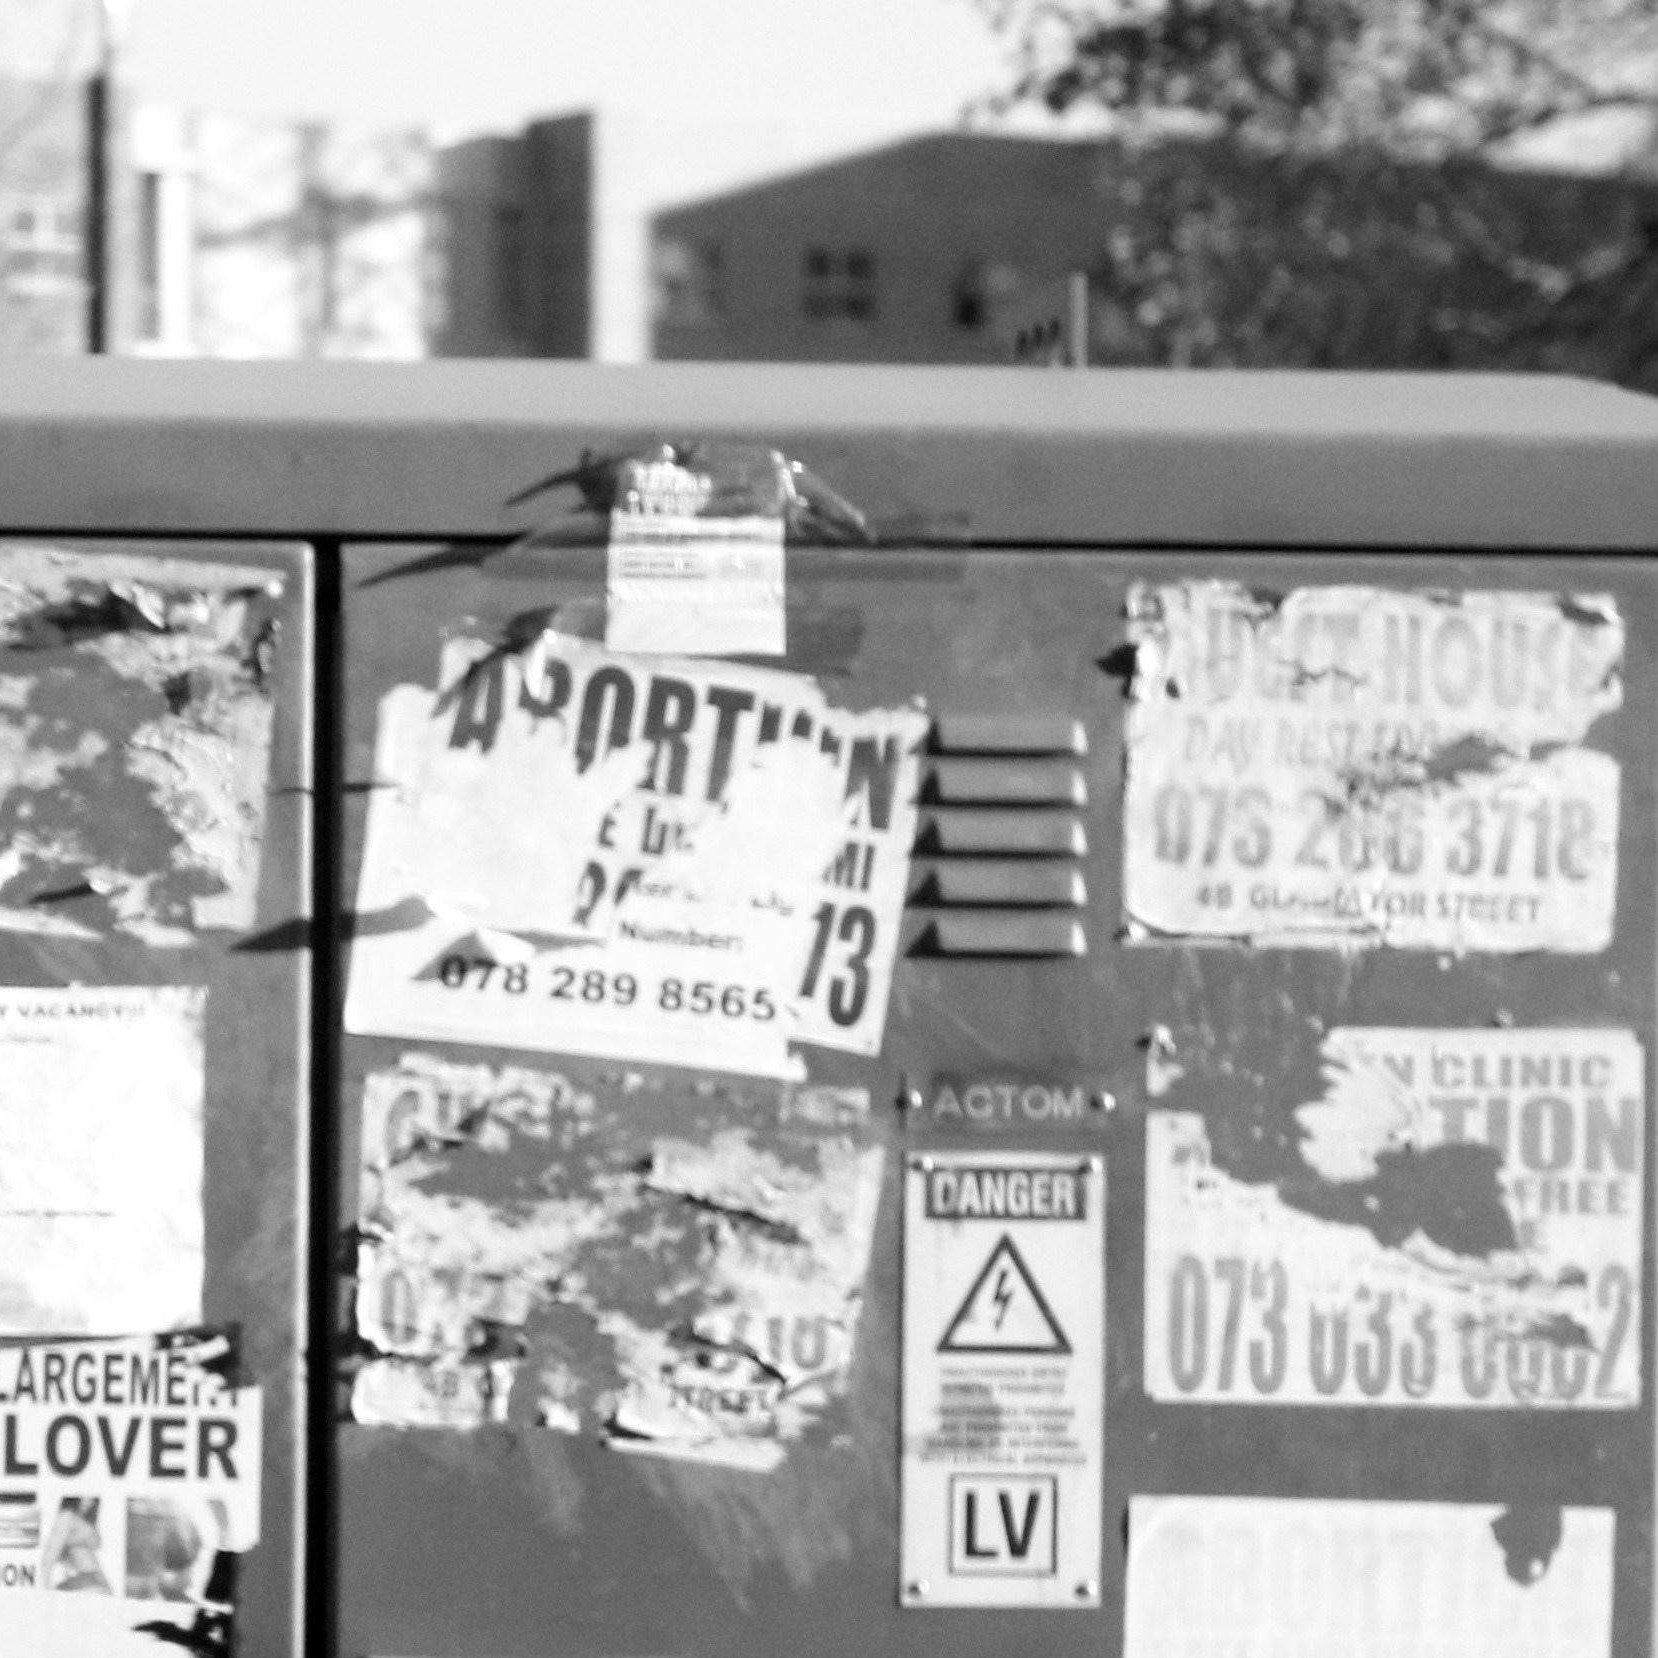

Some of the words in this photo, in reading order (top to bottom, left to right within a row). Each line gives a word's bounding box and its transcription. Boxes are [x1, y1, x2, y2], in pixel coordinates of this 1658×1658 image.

[550, 966, 638, 1005] 289
[658, 978, 776, 1022] 8565
[933, 1084, 1083, 1118] ACTOM
[932, 1171, 1076, 1218] DANGER
[1167, 1254, 1287, 1395] 073
[3, 1413, 239, 1481] LOVER
[965, 1489, 1041, 1559] LV
